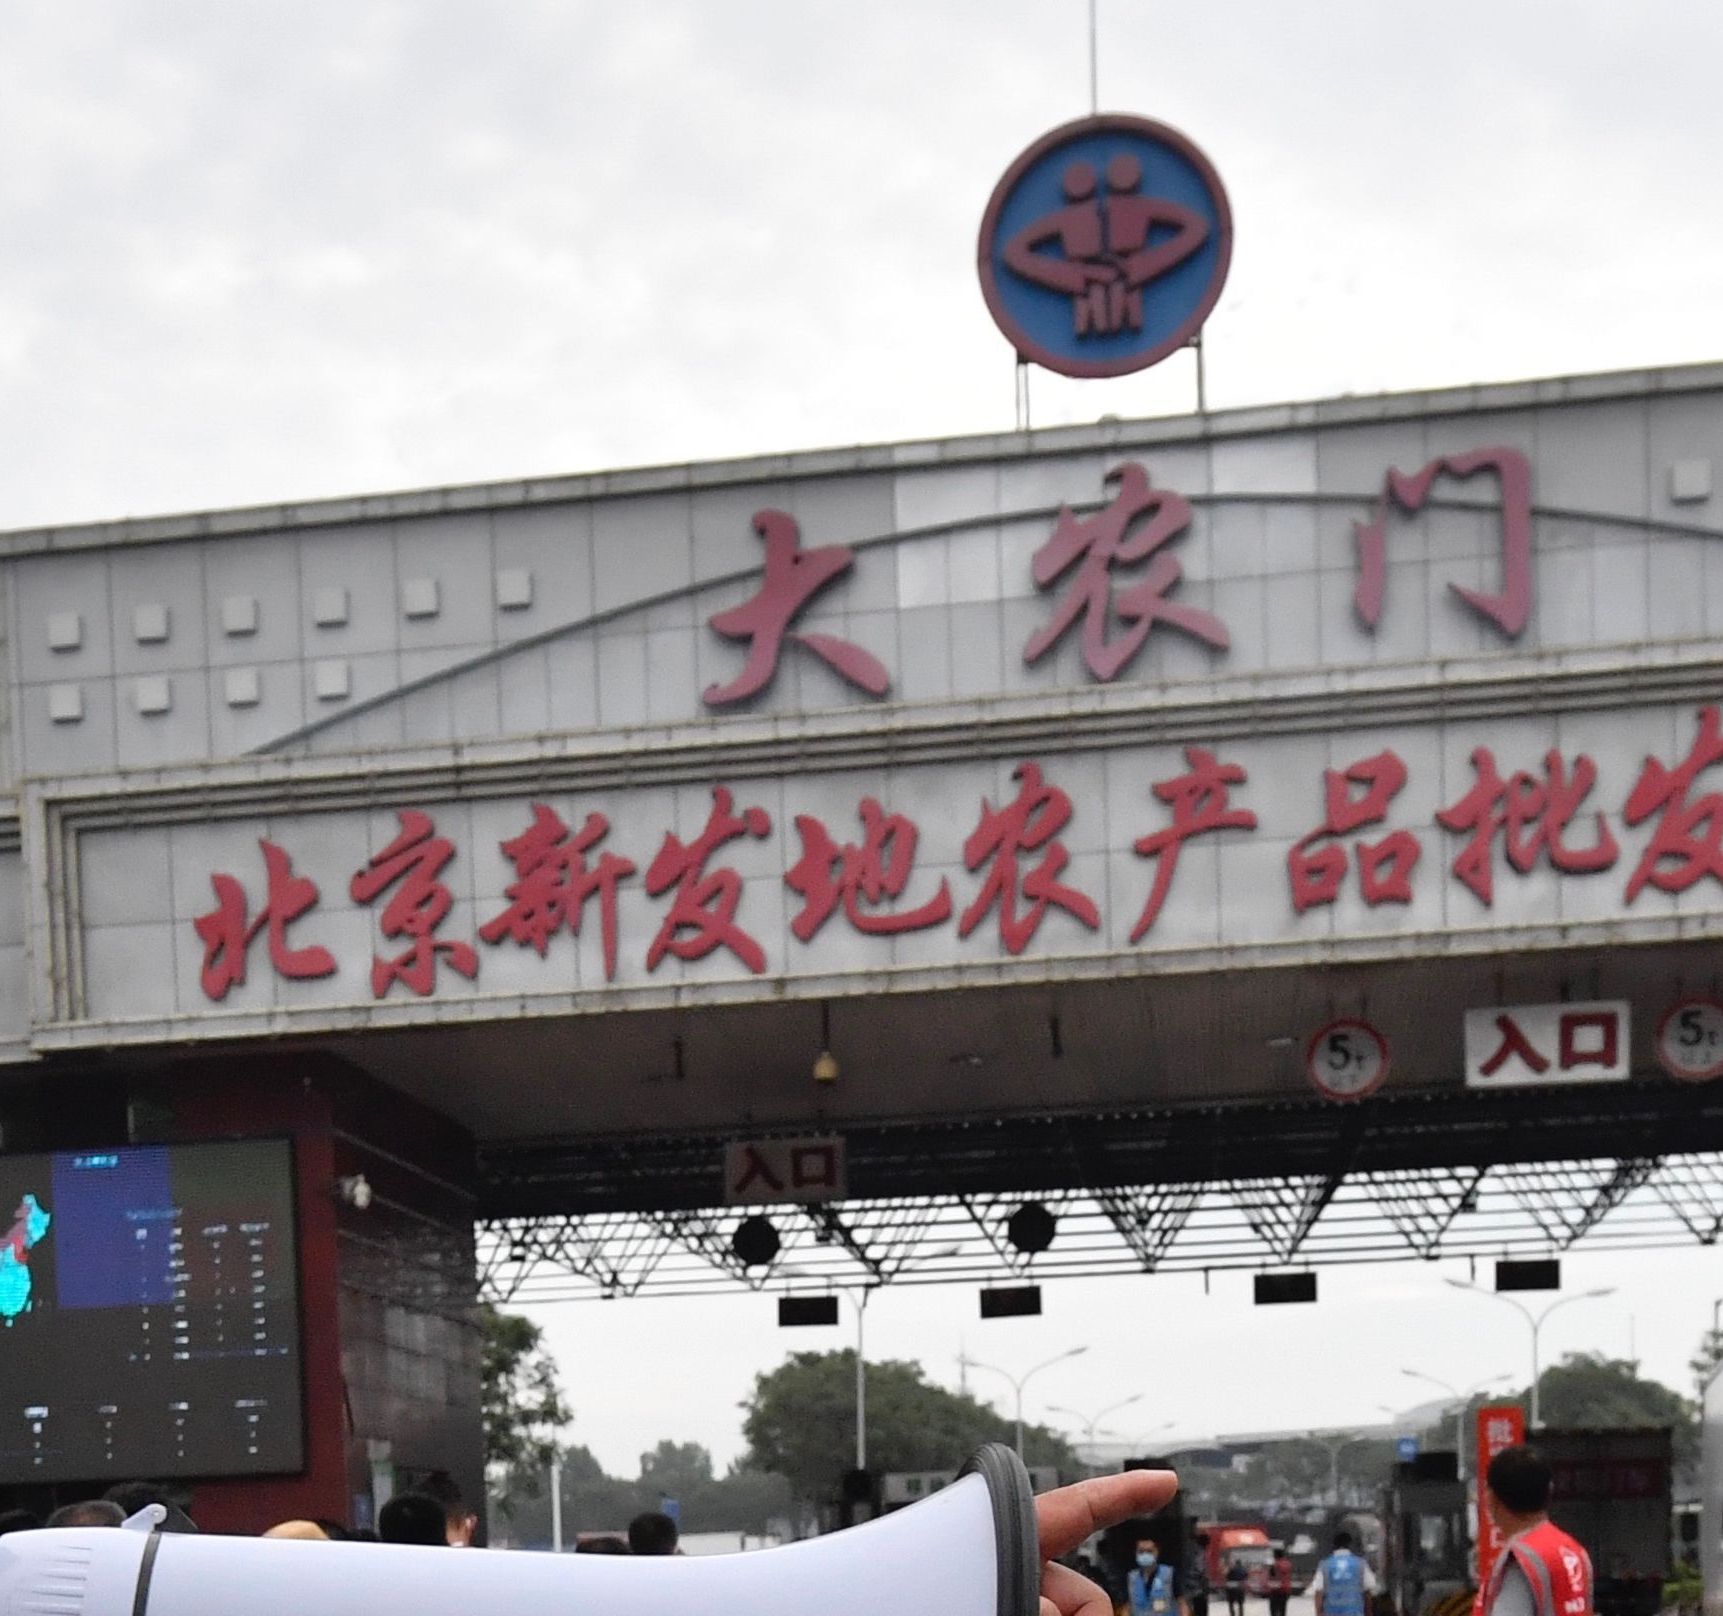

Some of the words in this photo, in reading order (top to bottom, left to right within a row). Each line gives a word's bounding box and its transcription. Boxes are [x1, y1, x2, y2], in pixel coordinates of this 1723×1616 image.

[702, 445, 1534, 707] 大农门
[1479, 1012, 1619, 1076] 入口
[734, 1143, 837, 1195] 入口
